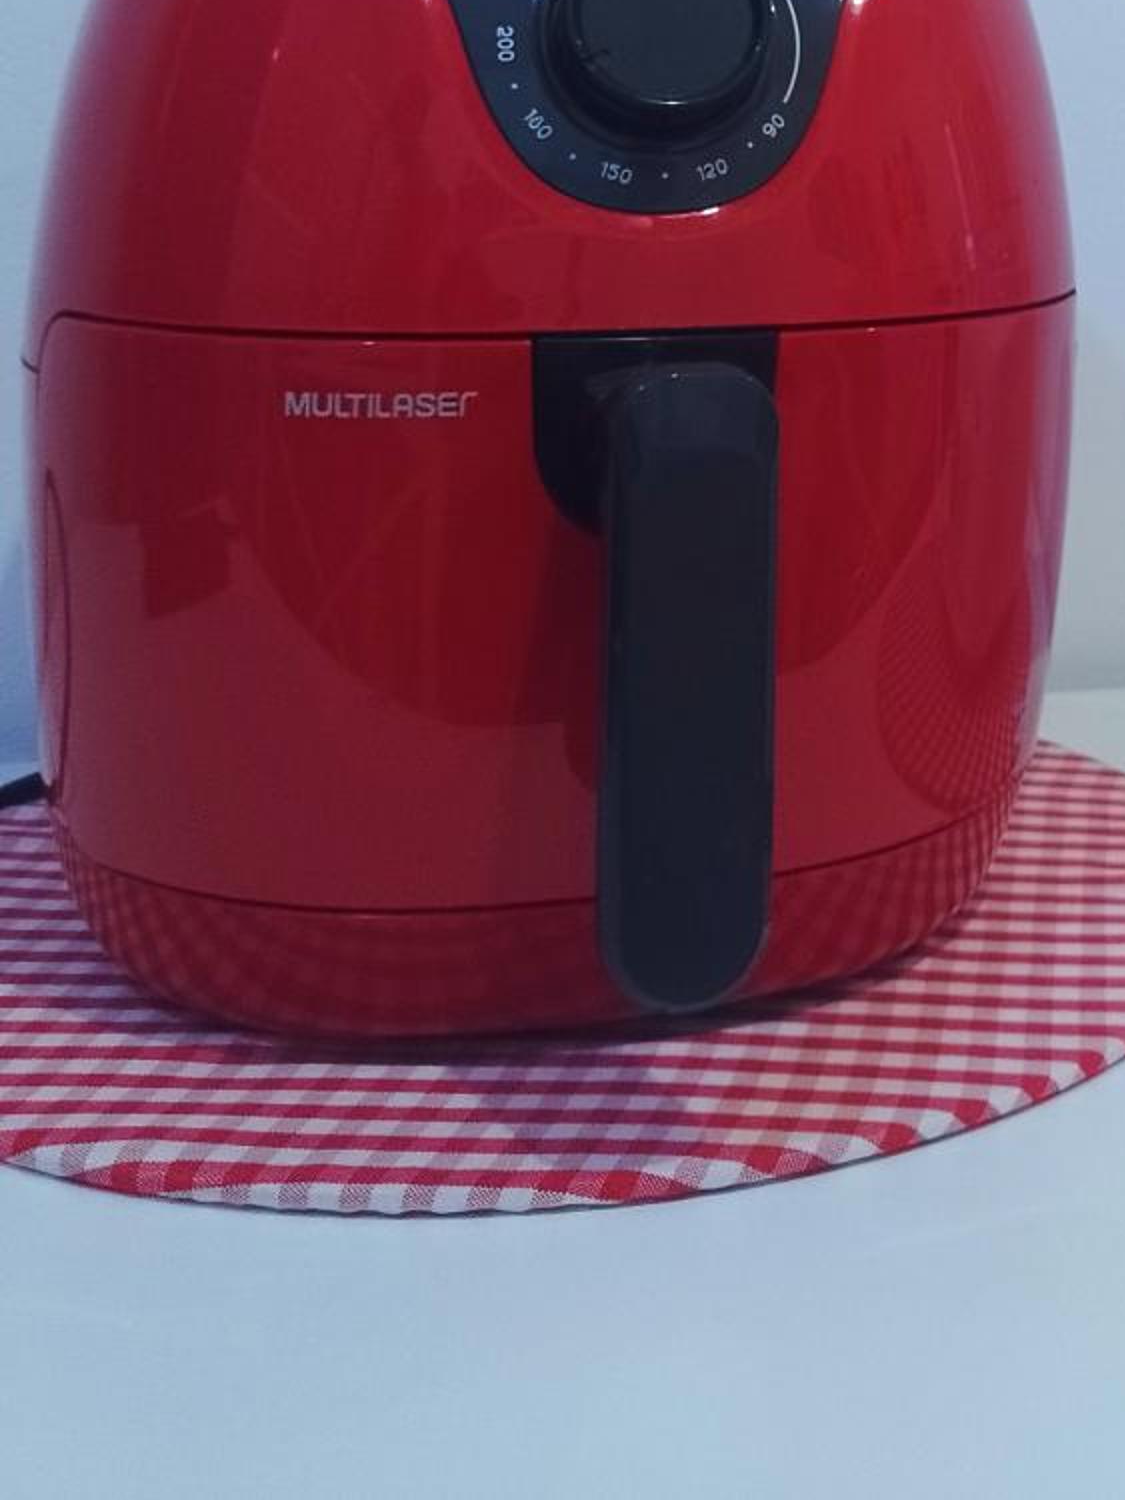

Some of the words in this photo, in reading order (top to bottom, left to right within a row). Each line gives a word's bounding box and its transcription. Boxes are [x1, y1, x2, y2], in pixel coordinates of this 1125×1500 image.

[496, 25, 515, 63] 200
[762, 113, 785, 139] 90
[600, 161, 633, 185] 150
[697, 158, 729, 182] 120
